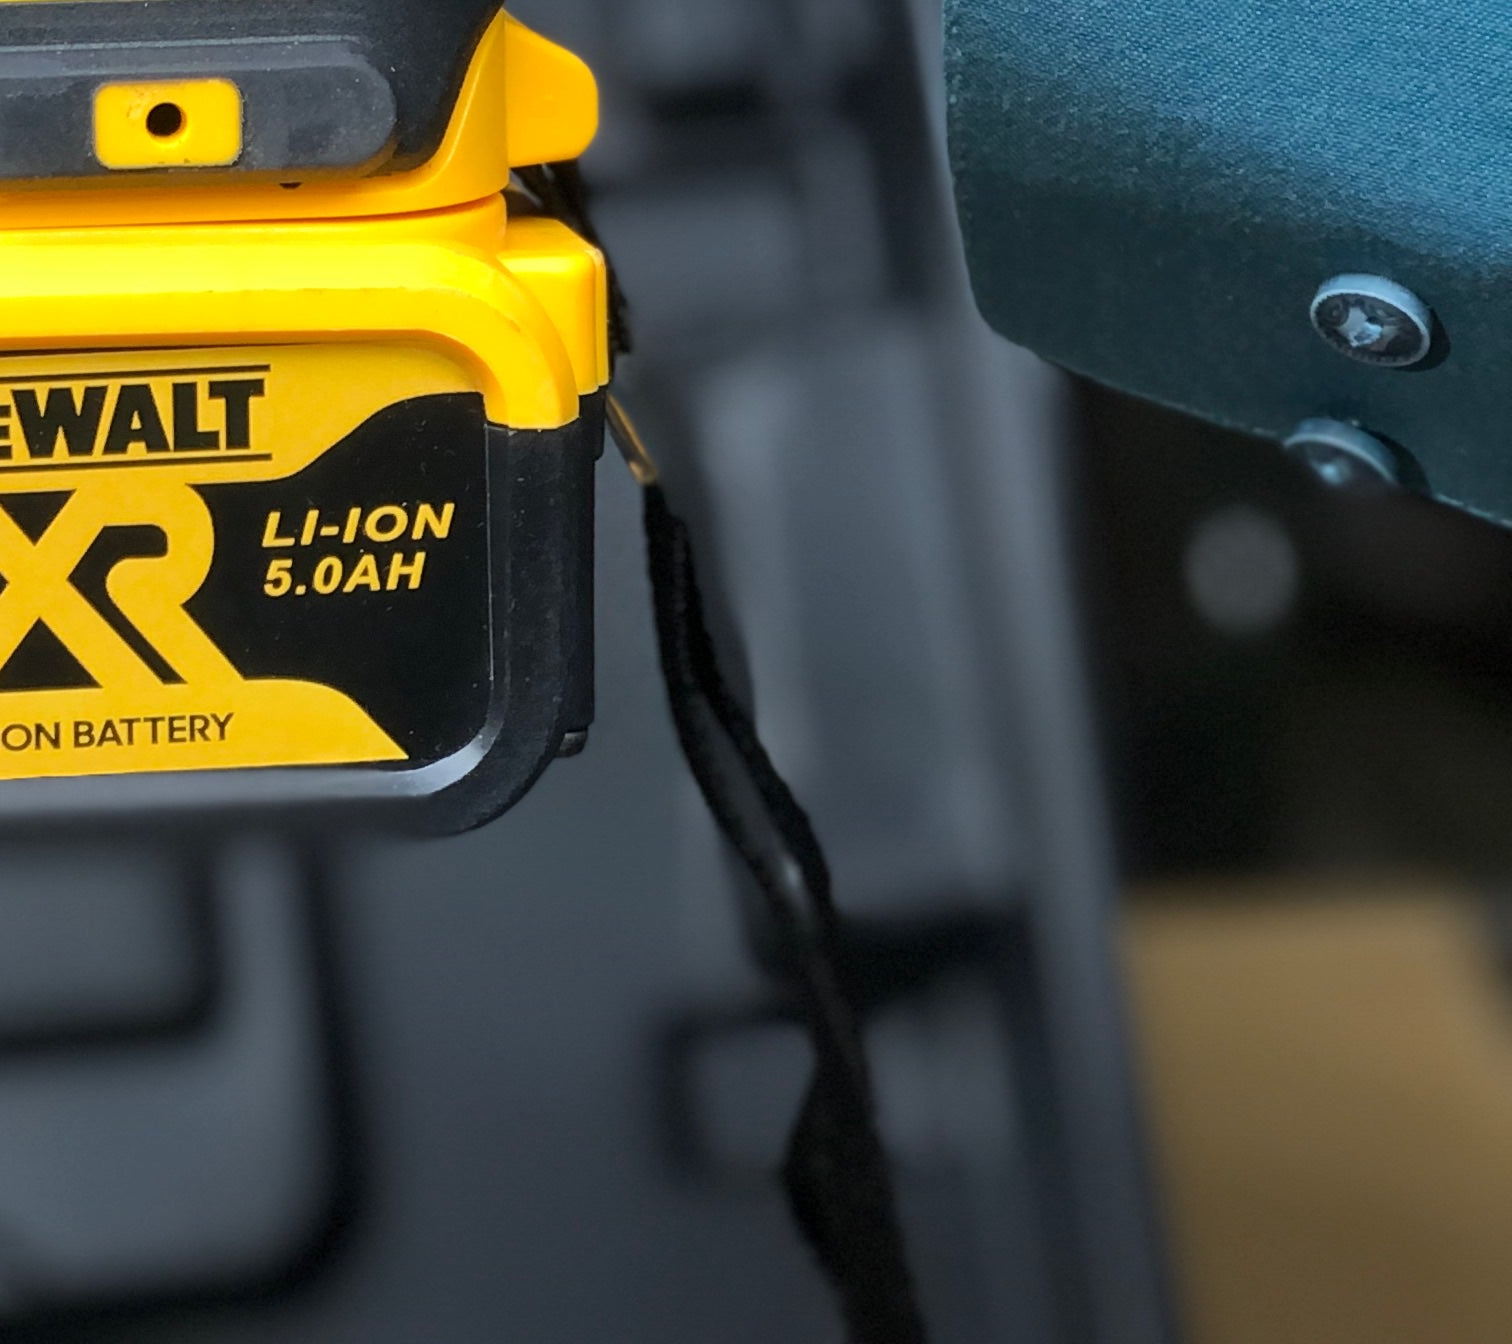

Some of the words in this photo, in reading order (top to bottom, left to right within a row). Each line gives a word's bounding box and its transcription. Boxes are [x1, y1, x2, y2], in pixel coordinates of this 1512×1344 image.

[261, 502, 455, 550] LI-ION
[263, 551, 426, 598] 5.0AH
[72, 712, 235, 750] BATTERY
